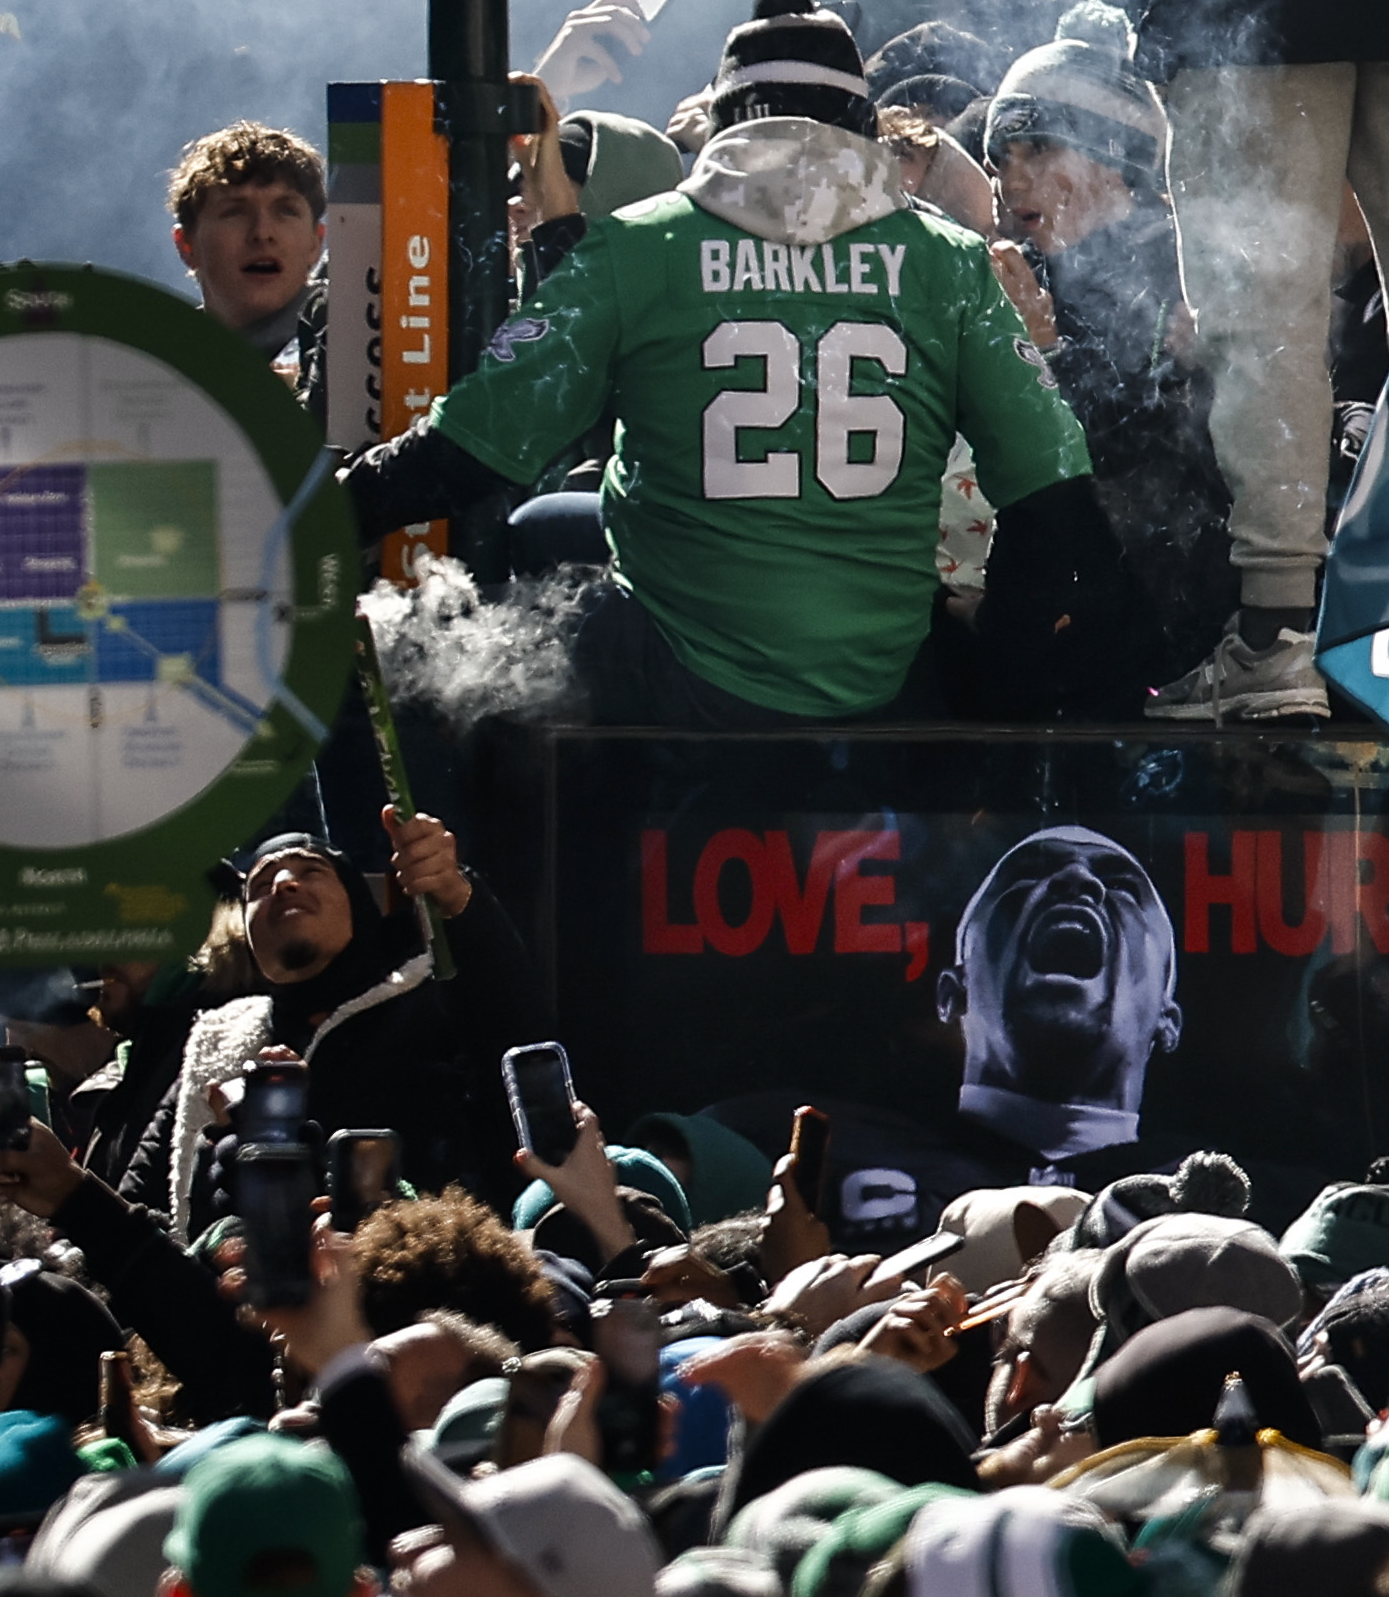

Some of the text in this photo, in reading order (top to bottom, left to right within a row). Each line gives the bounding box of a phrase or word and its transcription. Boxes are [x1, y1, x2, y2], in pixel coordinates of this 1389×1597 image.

[400, 234, 433, 366] Line
[700, 238, 908, 297] BARKLEY
[701, 319, 909, 502] 26
[639, 829, 930, 984] LOVE,
